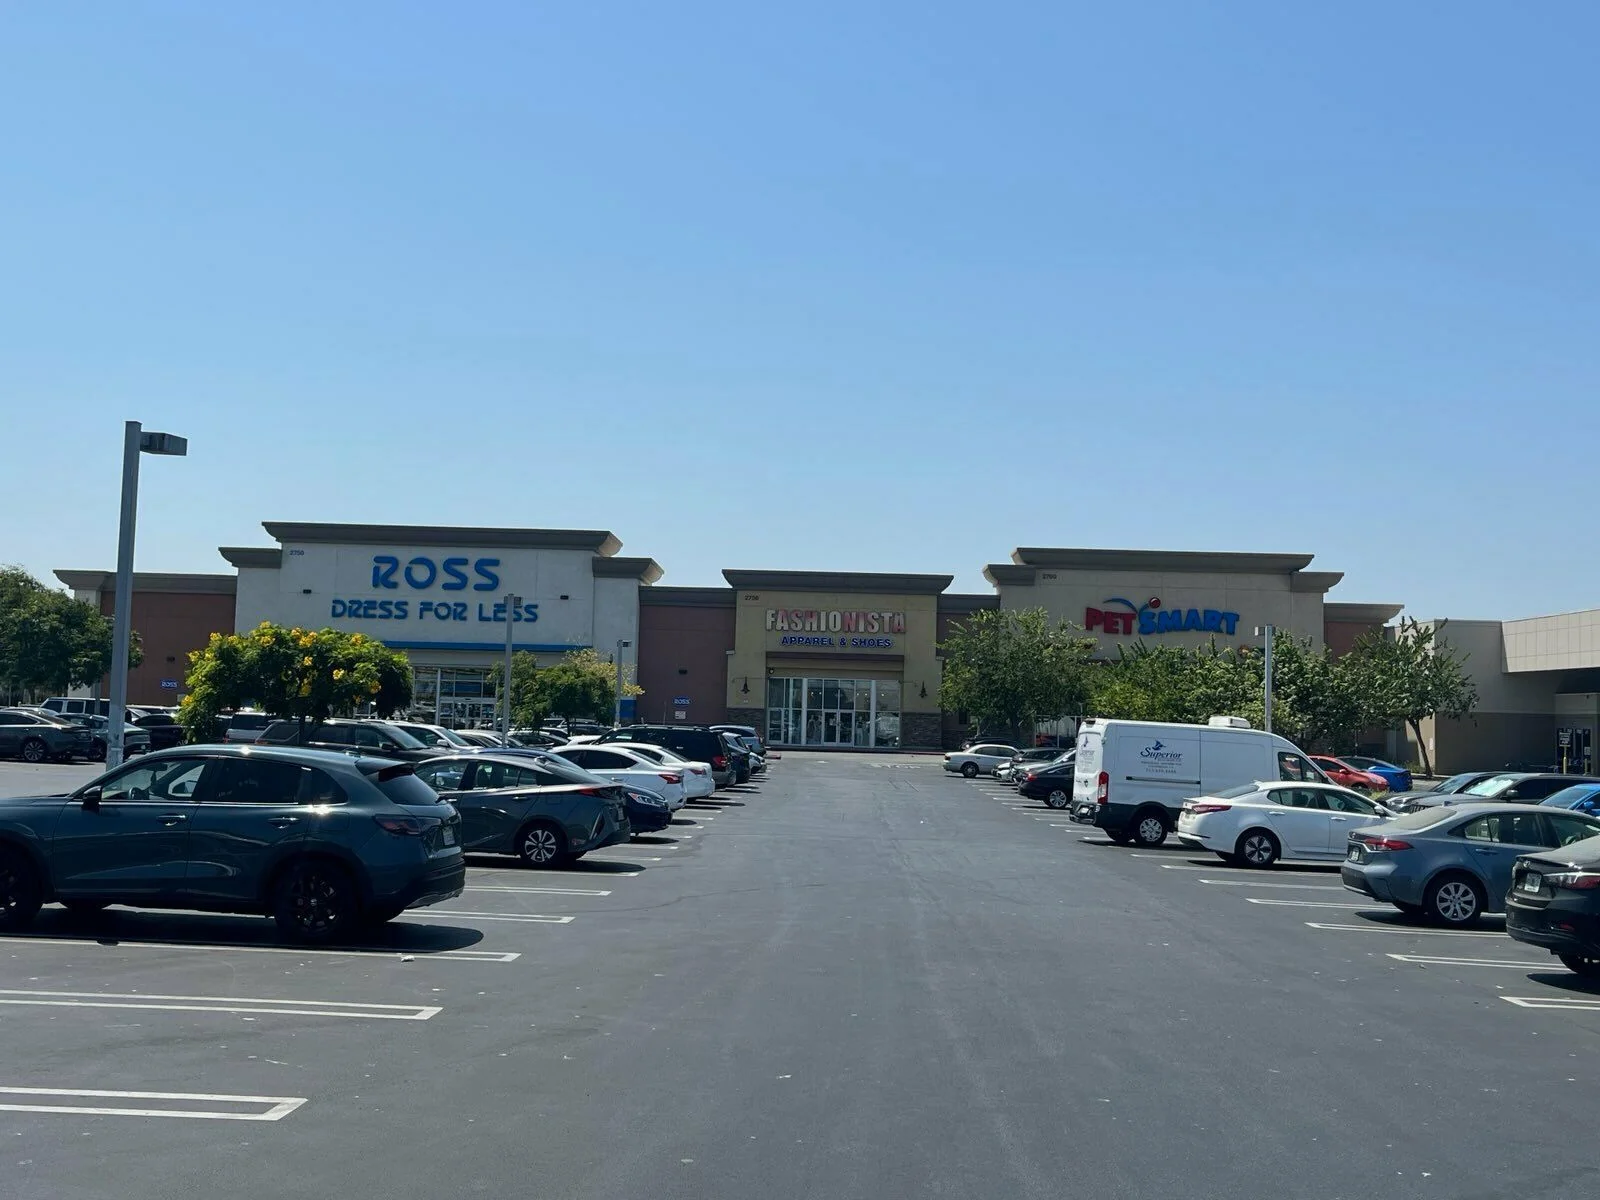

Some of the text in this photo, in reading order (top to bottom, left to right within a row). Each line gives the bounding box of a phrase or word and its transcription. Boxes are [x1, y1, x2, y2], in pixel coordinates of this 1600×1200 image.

[372, 555, 501, 592] ROSS
[331, 599, 539, 623] DRESS FOR LESS
[765, 609, 906, 634] FASHIONISTA
[781, 636, 892, 648] APPAREL & SHOES
[1140, 746, 1183, 760] Superior
